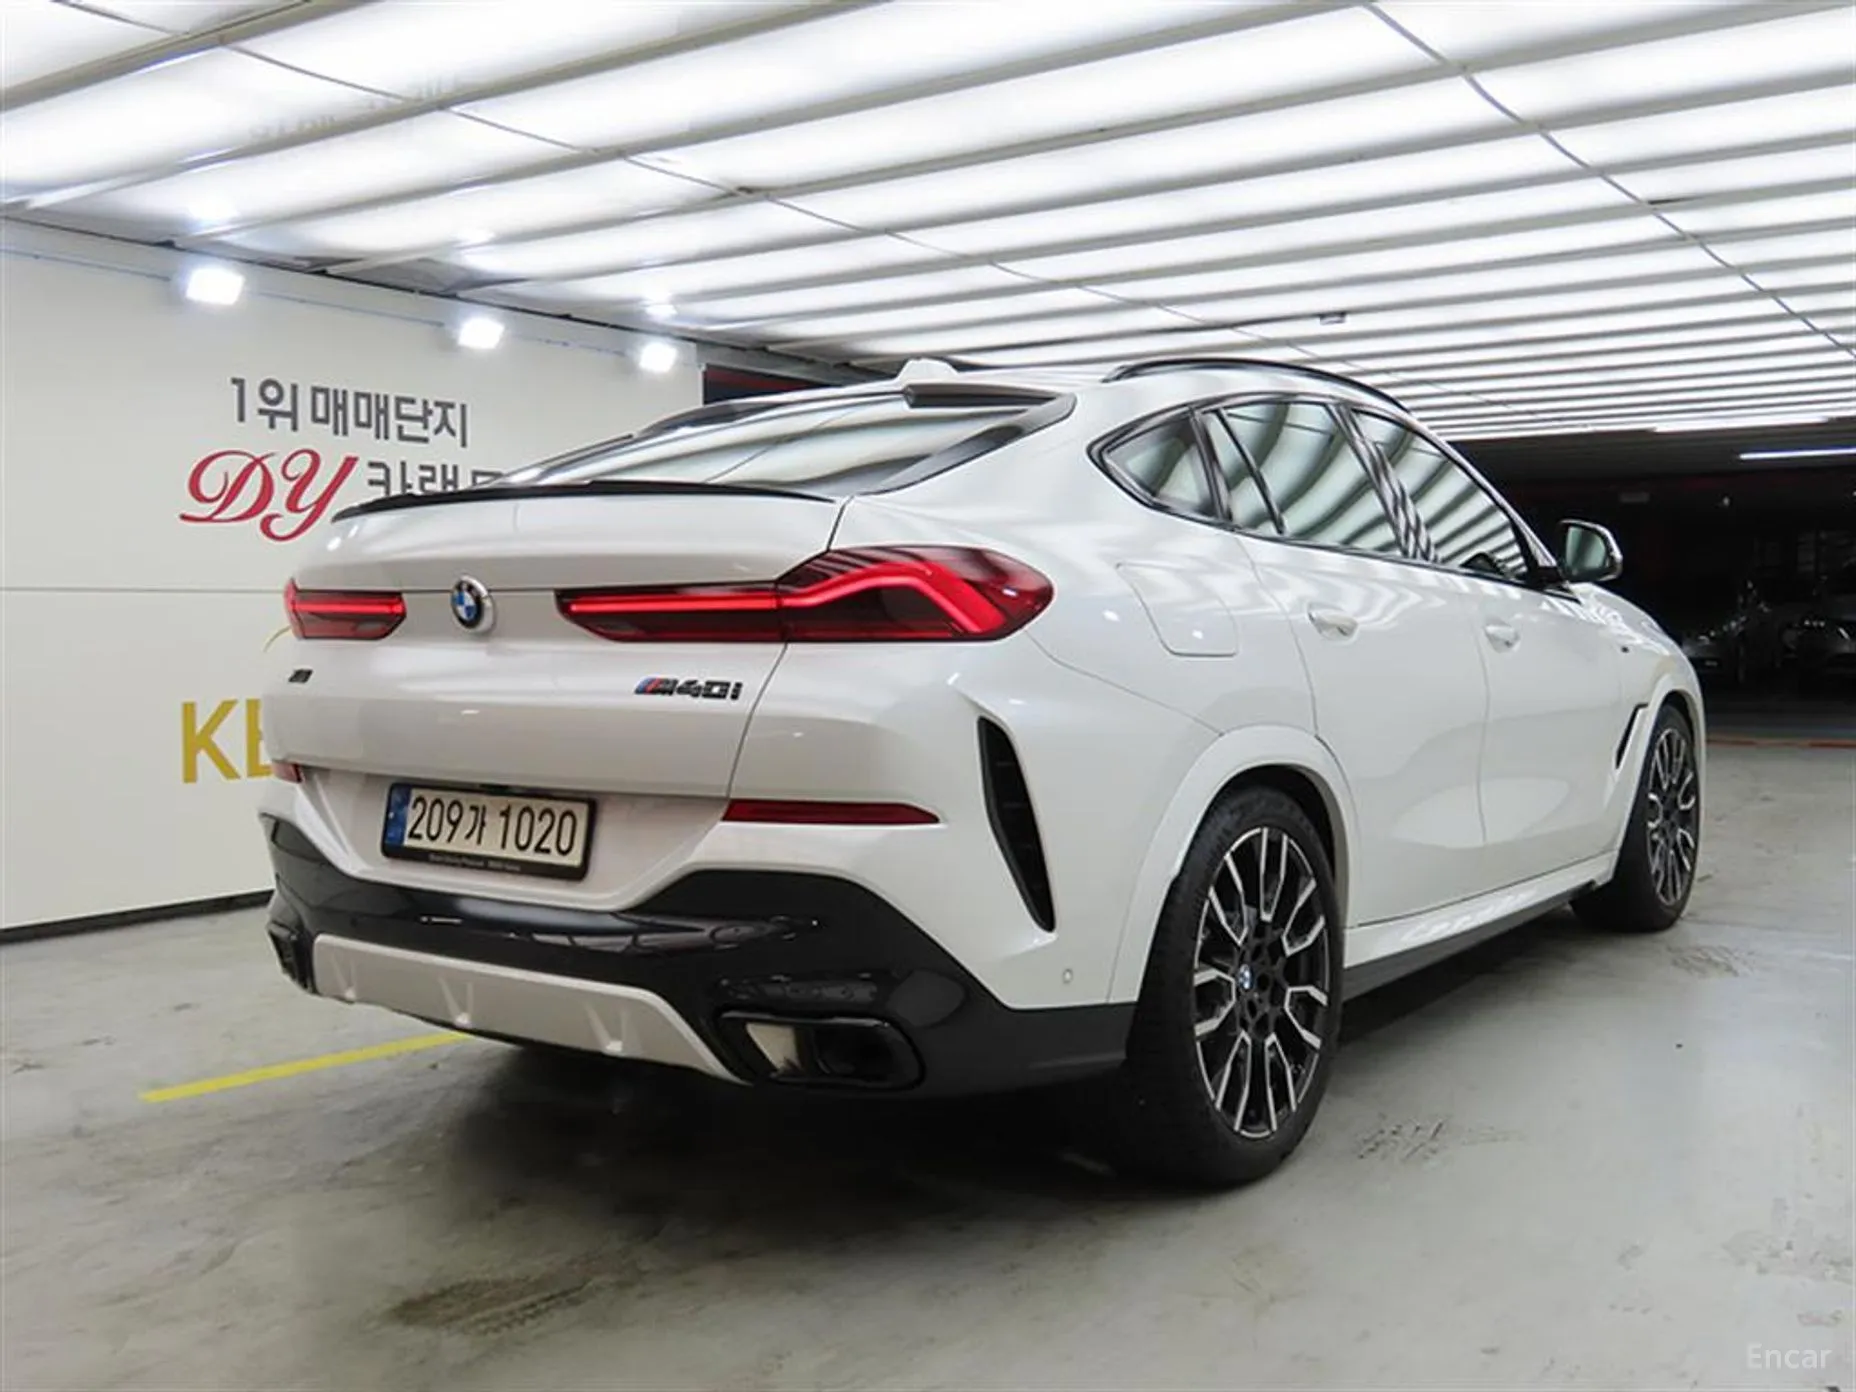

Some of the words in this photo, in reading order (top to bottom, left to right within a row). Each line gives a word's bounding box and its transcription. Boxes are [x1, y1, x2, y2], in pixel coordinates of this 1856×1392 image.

[230, 376, 299, 432] 1위
[310, 385, 468, 448] 매매단지
[179, 448, 359, 542] DY
[407, 796, 487, 845] 209가
[499, 804, 578, 856] 1020
